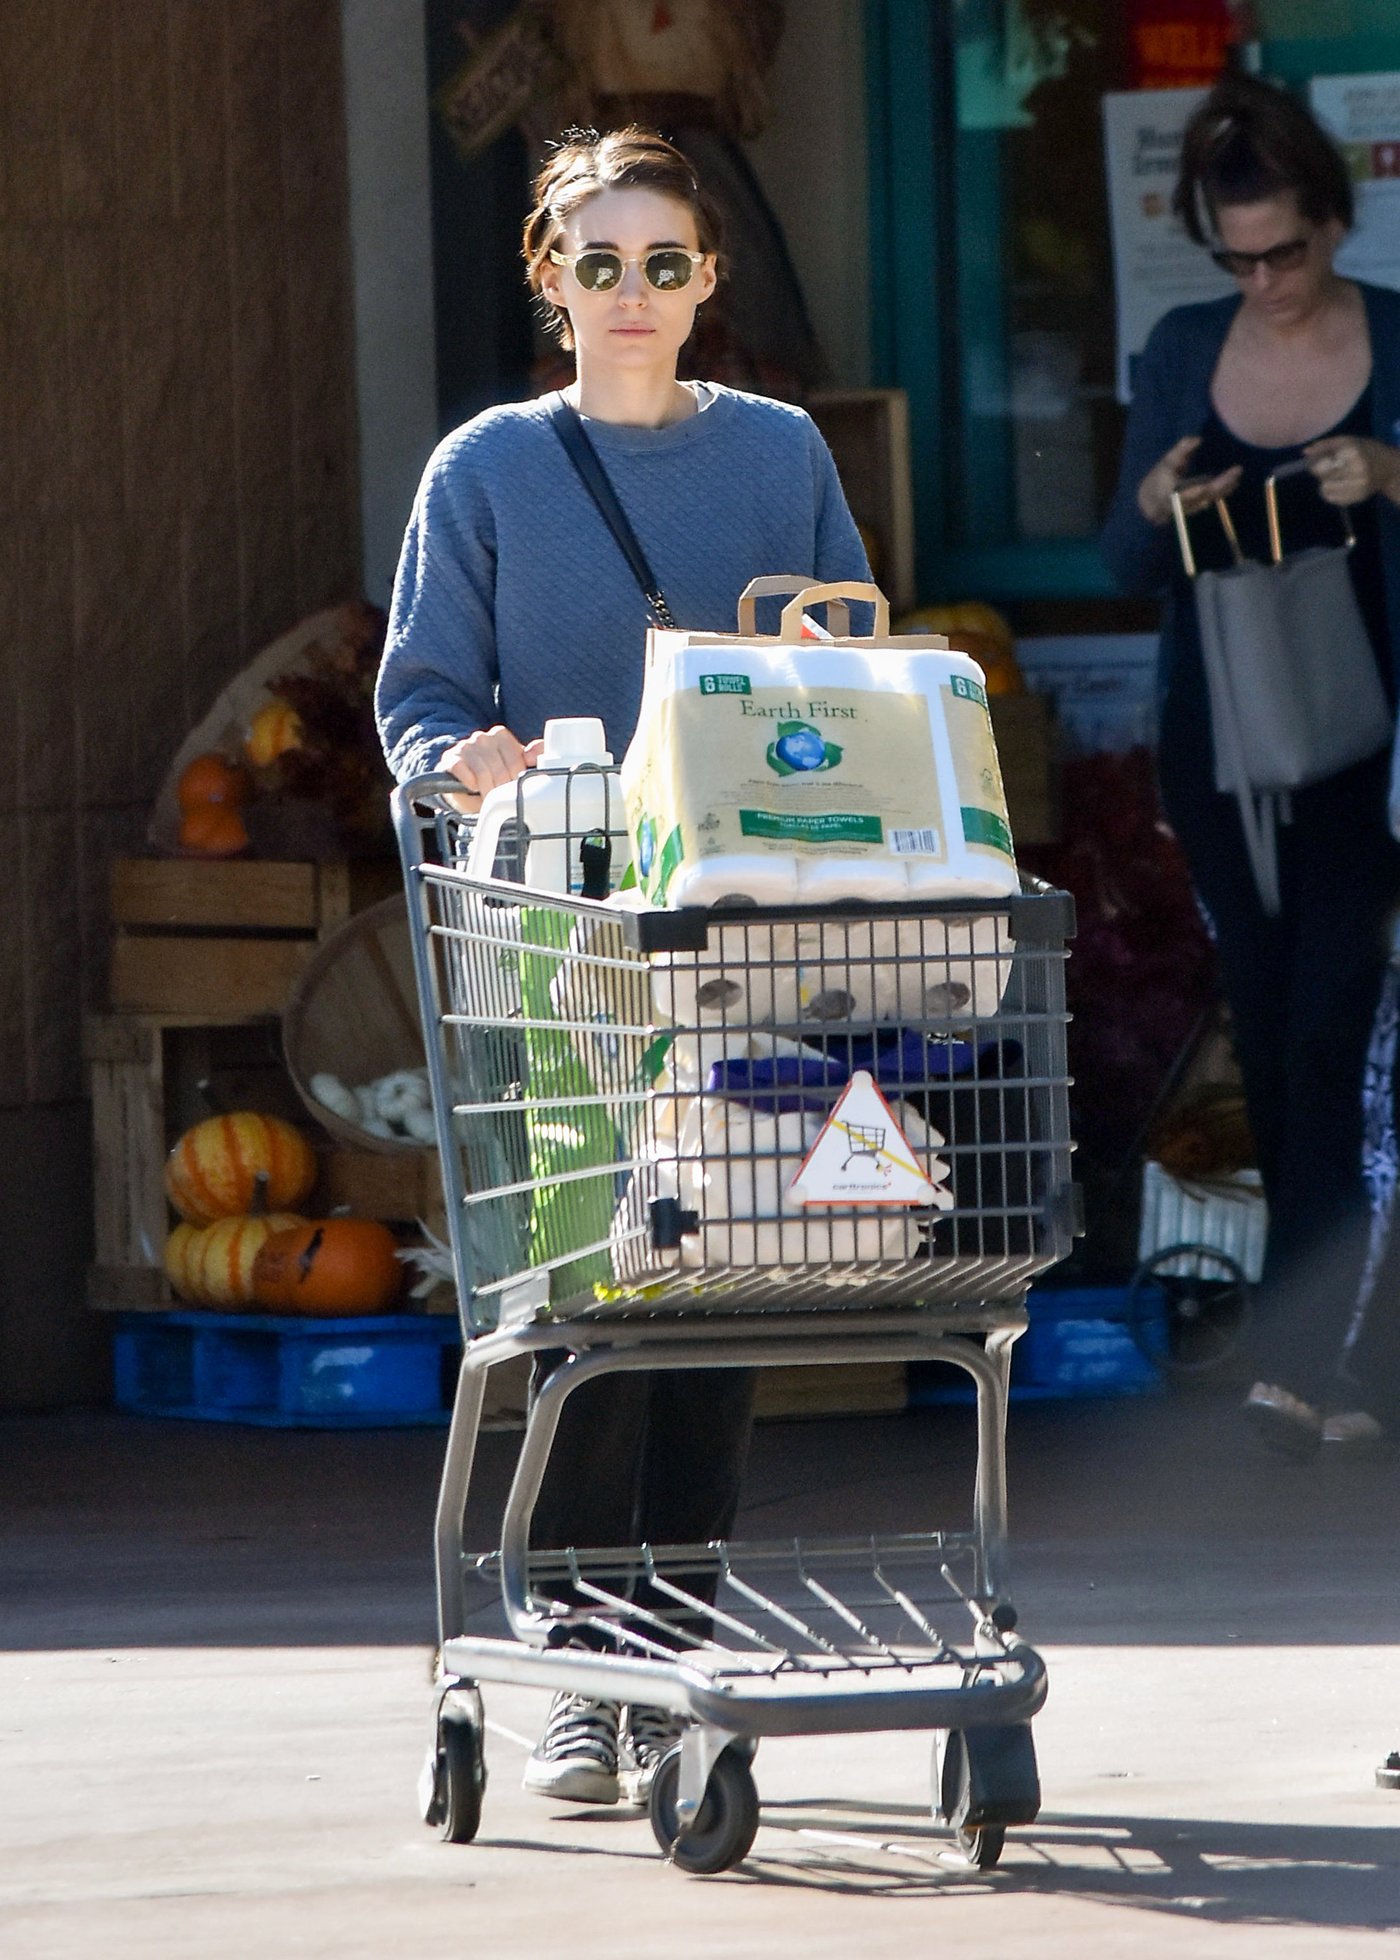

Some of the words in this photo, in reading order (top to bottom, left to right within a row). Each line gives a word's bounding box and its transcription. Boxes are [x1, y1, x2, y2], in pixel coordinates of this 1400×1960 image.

[704, 676, 716, 693] 6
[955, 676, 968, 696] 6
[739, 699, 801, 719] Earth
[808, 700, 859, 720] First
[757, 812, 795, 823] PREMIUM
[796, 817, 825, 825] PAPER
[828, 816, 864, 824] TOWELS
